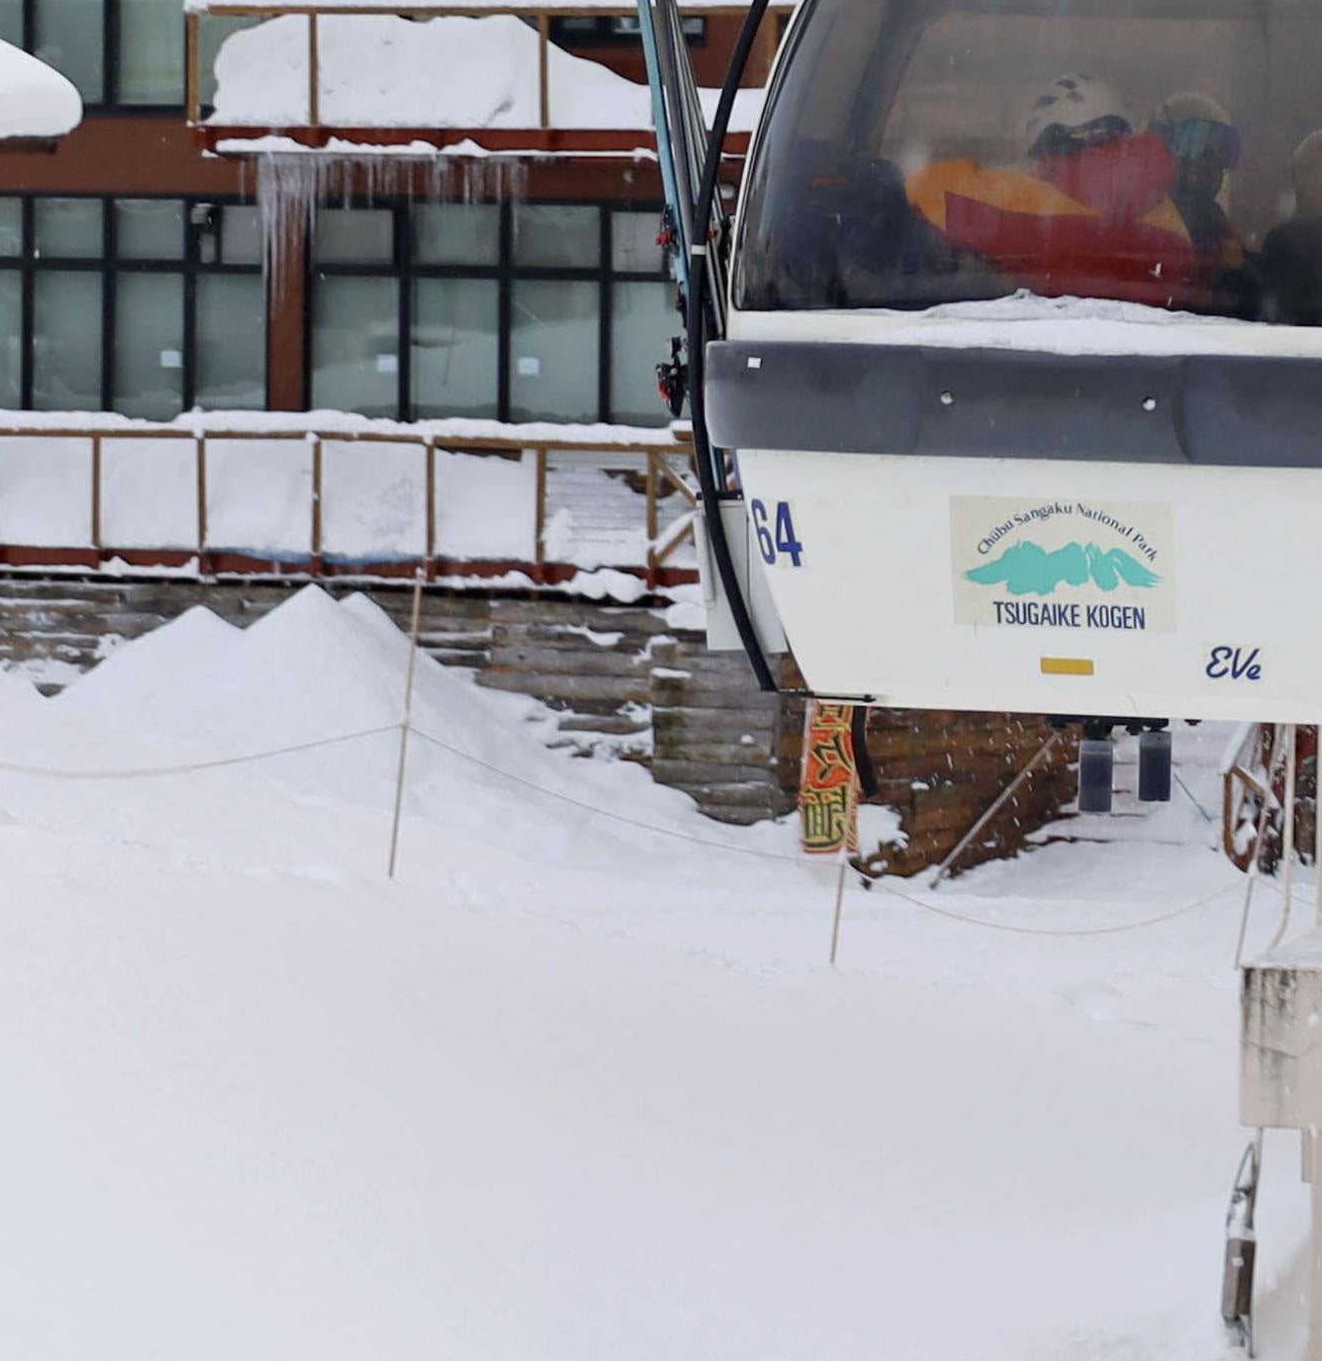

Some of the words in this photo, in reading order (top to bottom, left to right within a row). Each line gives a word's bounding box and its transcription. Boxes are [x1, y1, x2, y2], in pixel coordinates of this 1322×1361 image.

[751, 498, 803, 567] 64
[1014, 502, 1073, 526] Sangaku
[1076, 503, 1134, 538] National
[1131, 533, 1159, 562] Park
[993, 601, 1080, 627] TSUGAIKE
[1087, 604, 1145, 630] KOGEN
